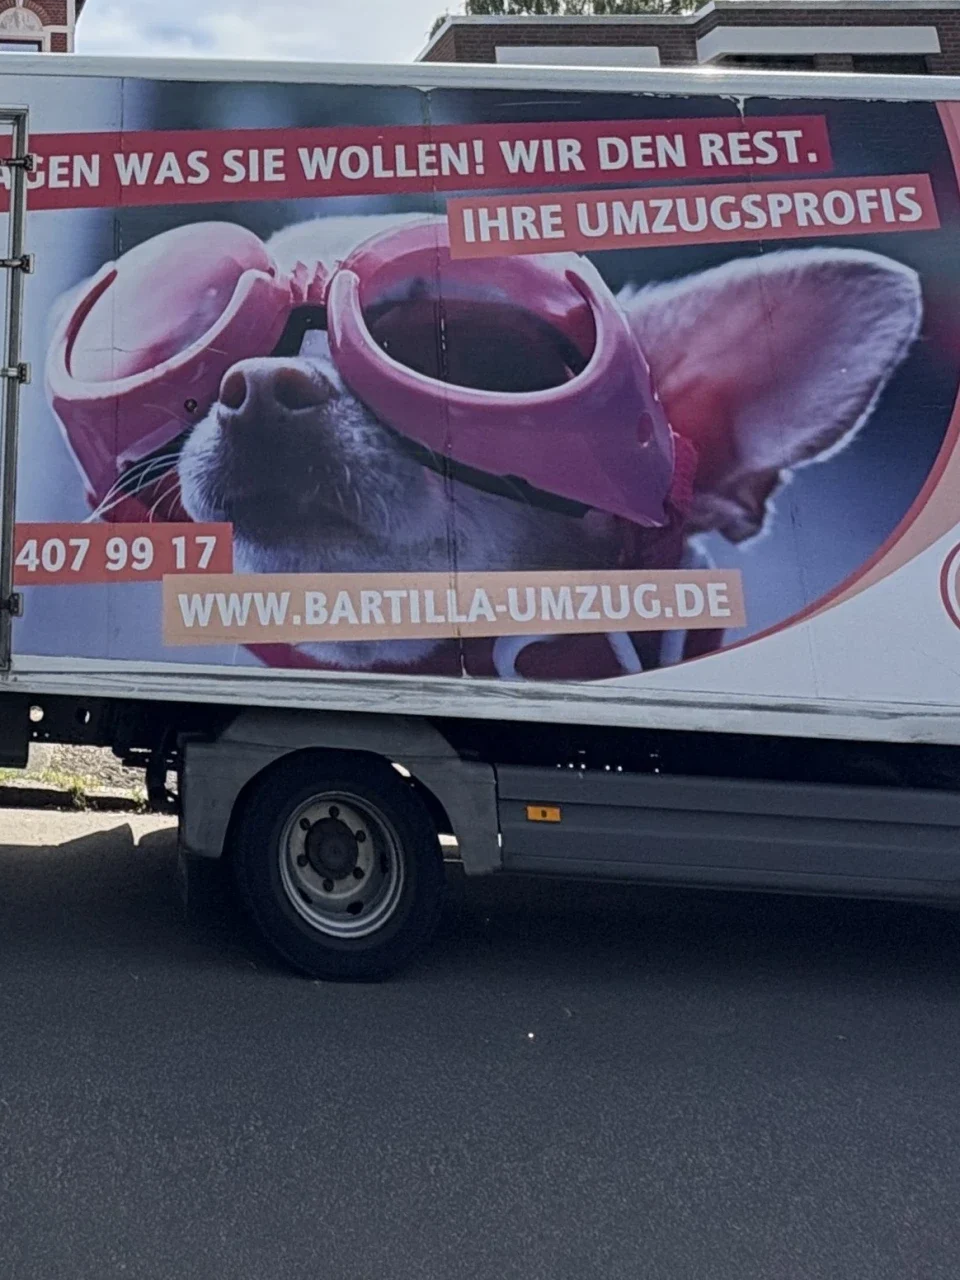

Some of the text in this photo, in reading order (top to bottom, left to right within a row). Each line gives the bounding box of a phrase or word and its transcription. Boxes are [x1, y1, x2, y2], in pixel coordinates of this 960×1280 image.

[114, 150, 210, 186] WAS
[222, 148, 286, 184] SIE
[297, 139, 485, 181] WOLLEN!
[498, 138, 586, 175] WIR
[596, 133, 687, 171] DEN
[699, 129, 819, 167] REST.
[462, 186, 923, 244] IHRE UMZUGSPROFIS
[14, 537, 91, 573] 407
[105, 535, 154, 571] 99
[171, 535, 217, 570] 17
[178, 582, 732, 627] WWW.BARTILLA-UMZUG.DE
